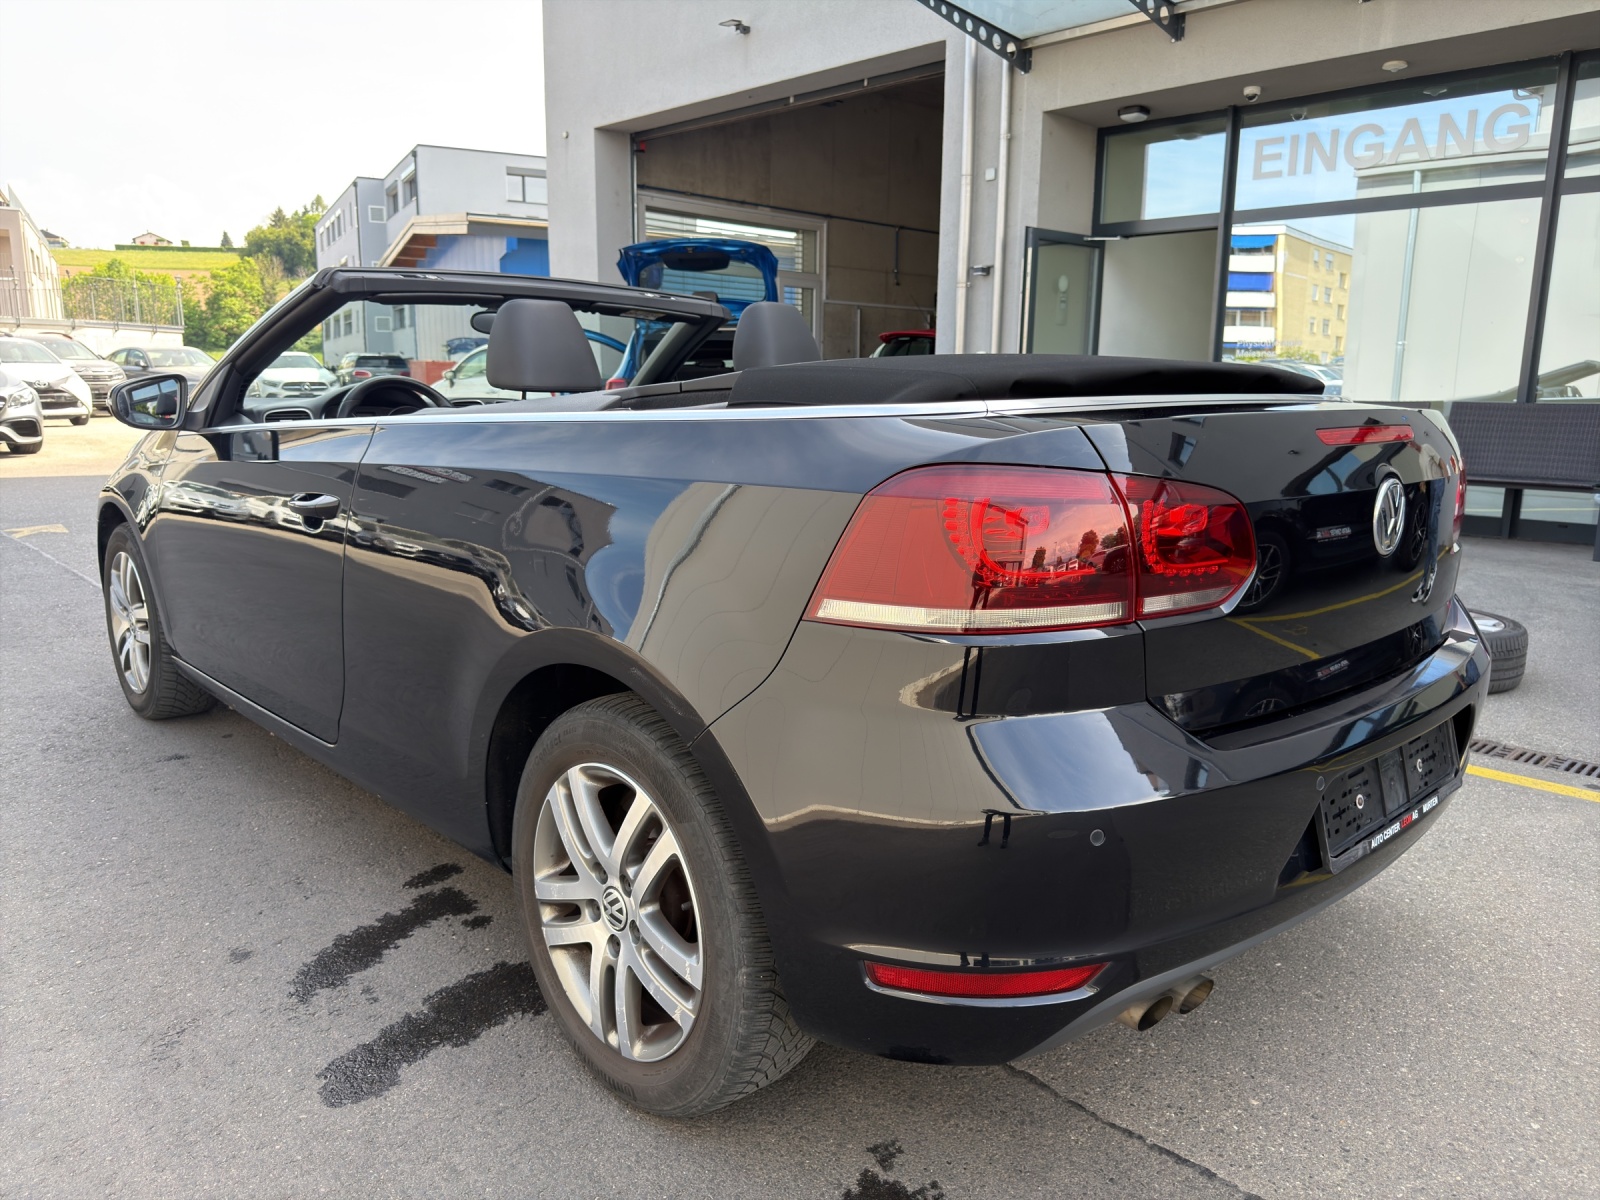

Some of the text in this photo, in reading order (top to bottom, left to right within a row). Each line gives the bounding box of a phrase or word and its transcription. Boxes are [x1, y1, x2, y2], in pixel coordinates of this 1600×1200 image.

[1252, 103, 1531, 181] EINGANG
[1371, 833, 1384, 849] AUTO
[1384, 822, 1400, 840] CENTER
[1412, 809, 1419, 821] AG
